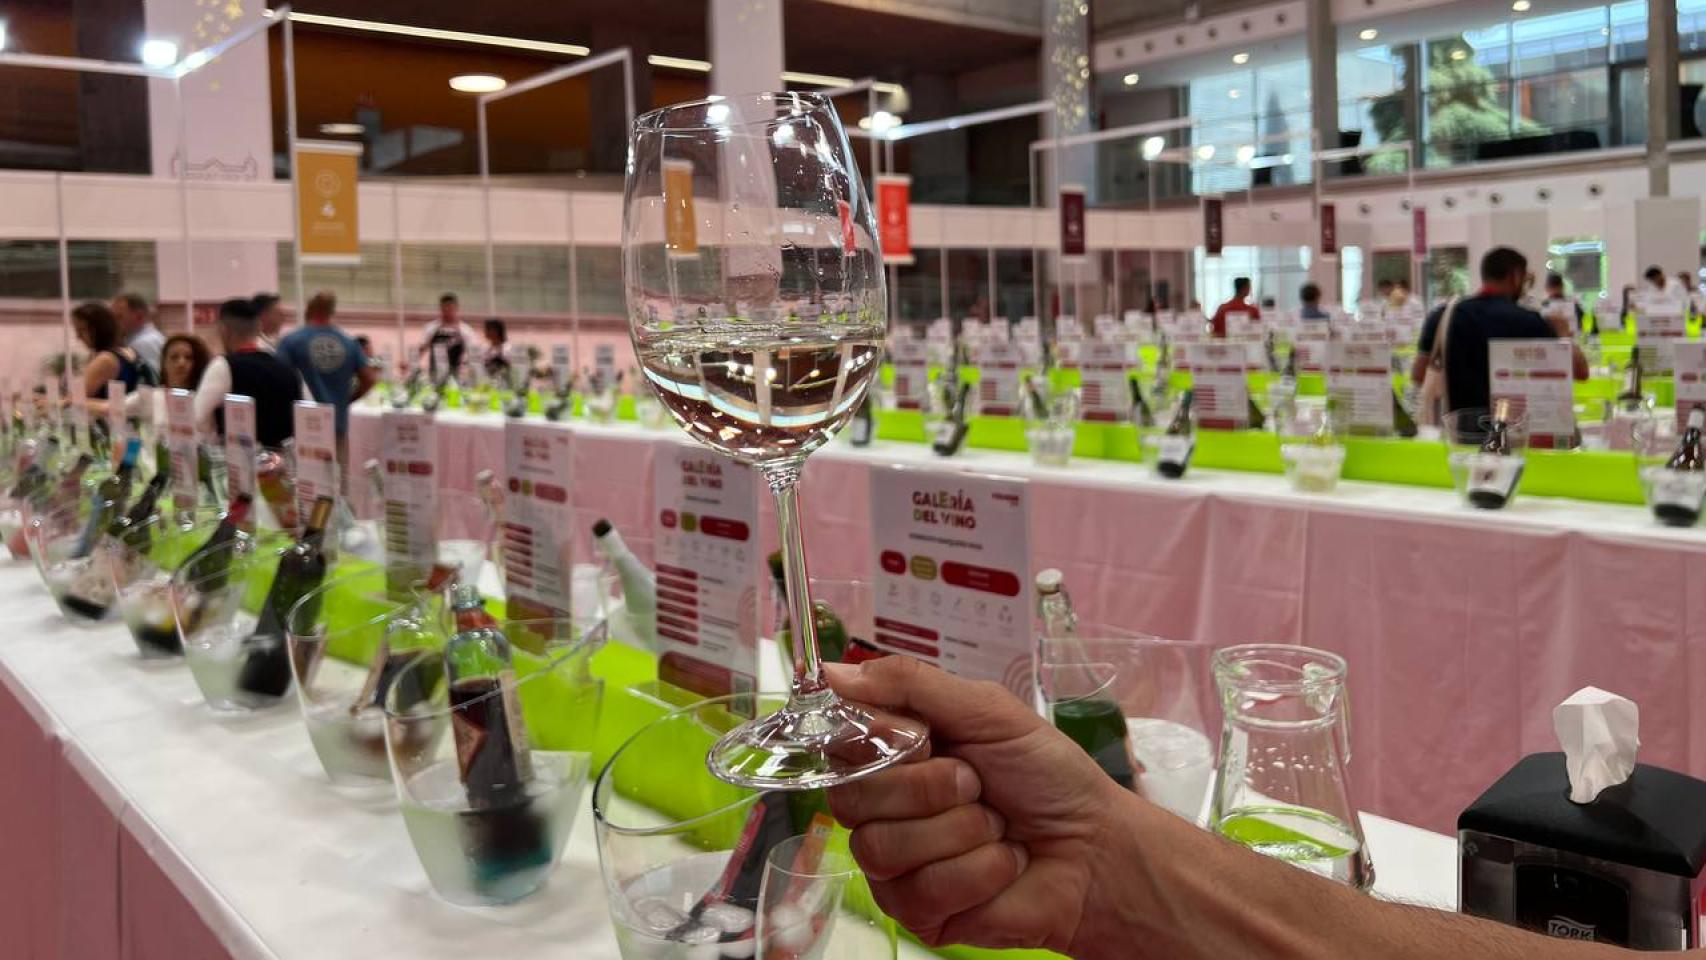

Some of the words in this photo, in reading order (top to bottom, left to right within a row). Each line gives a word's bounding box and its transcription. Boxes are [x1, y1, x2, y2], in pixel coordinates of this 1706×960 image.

[912, 489, 975, 512] GALERÍA
[914, 508, 938, 524] DEL
[941, 512, 976, 529] VINO
[1550, 921, 1594, 938] TORK
